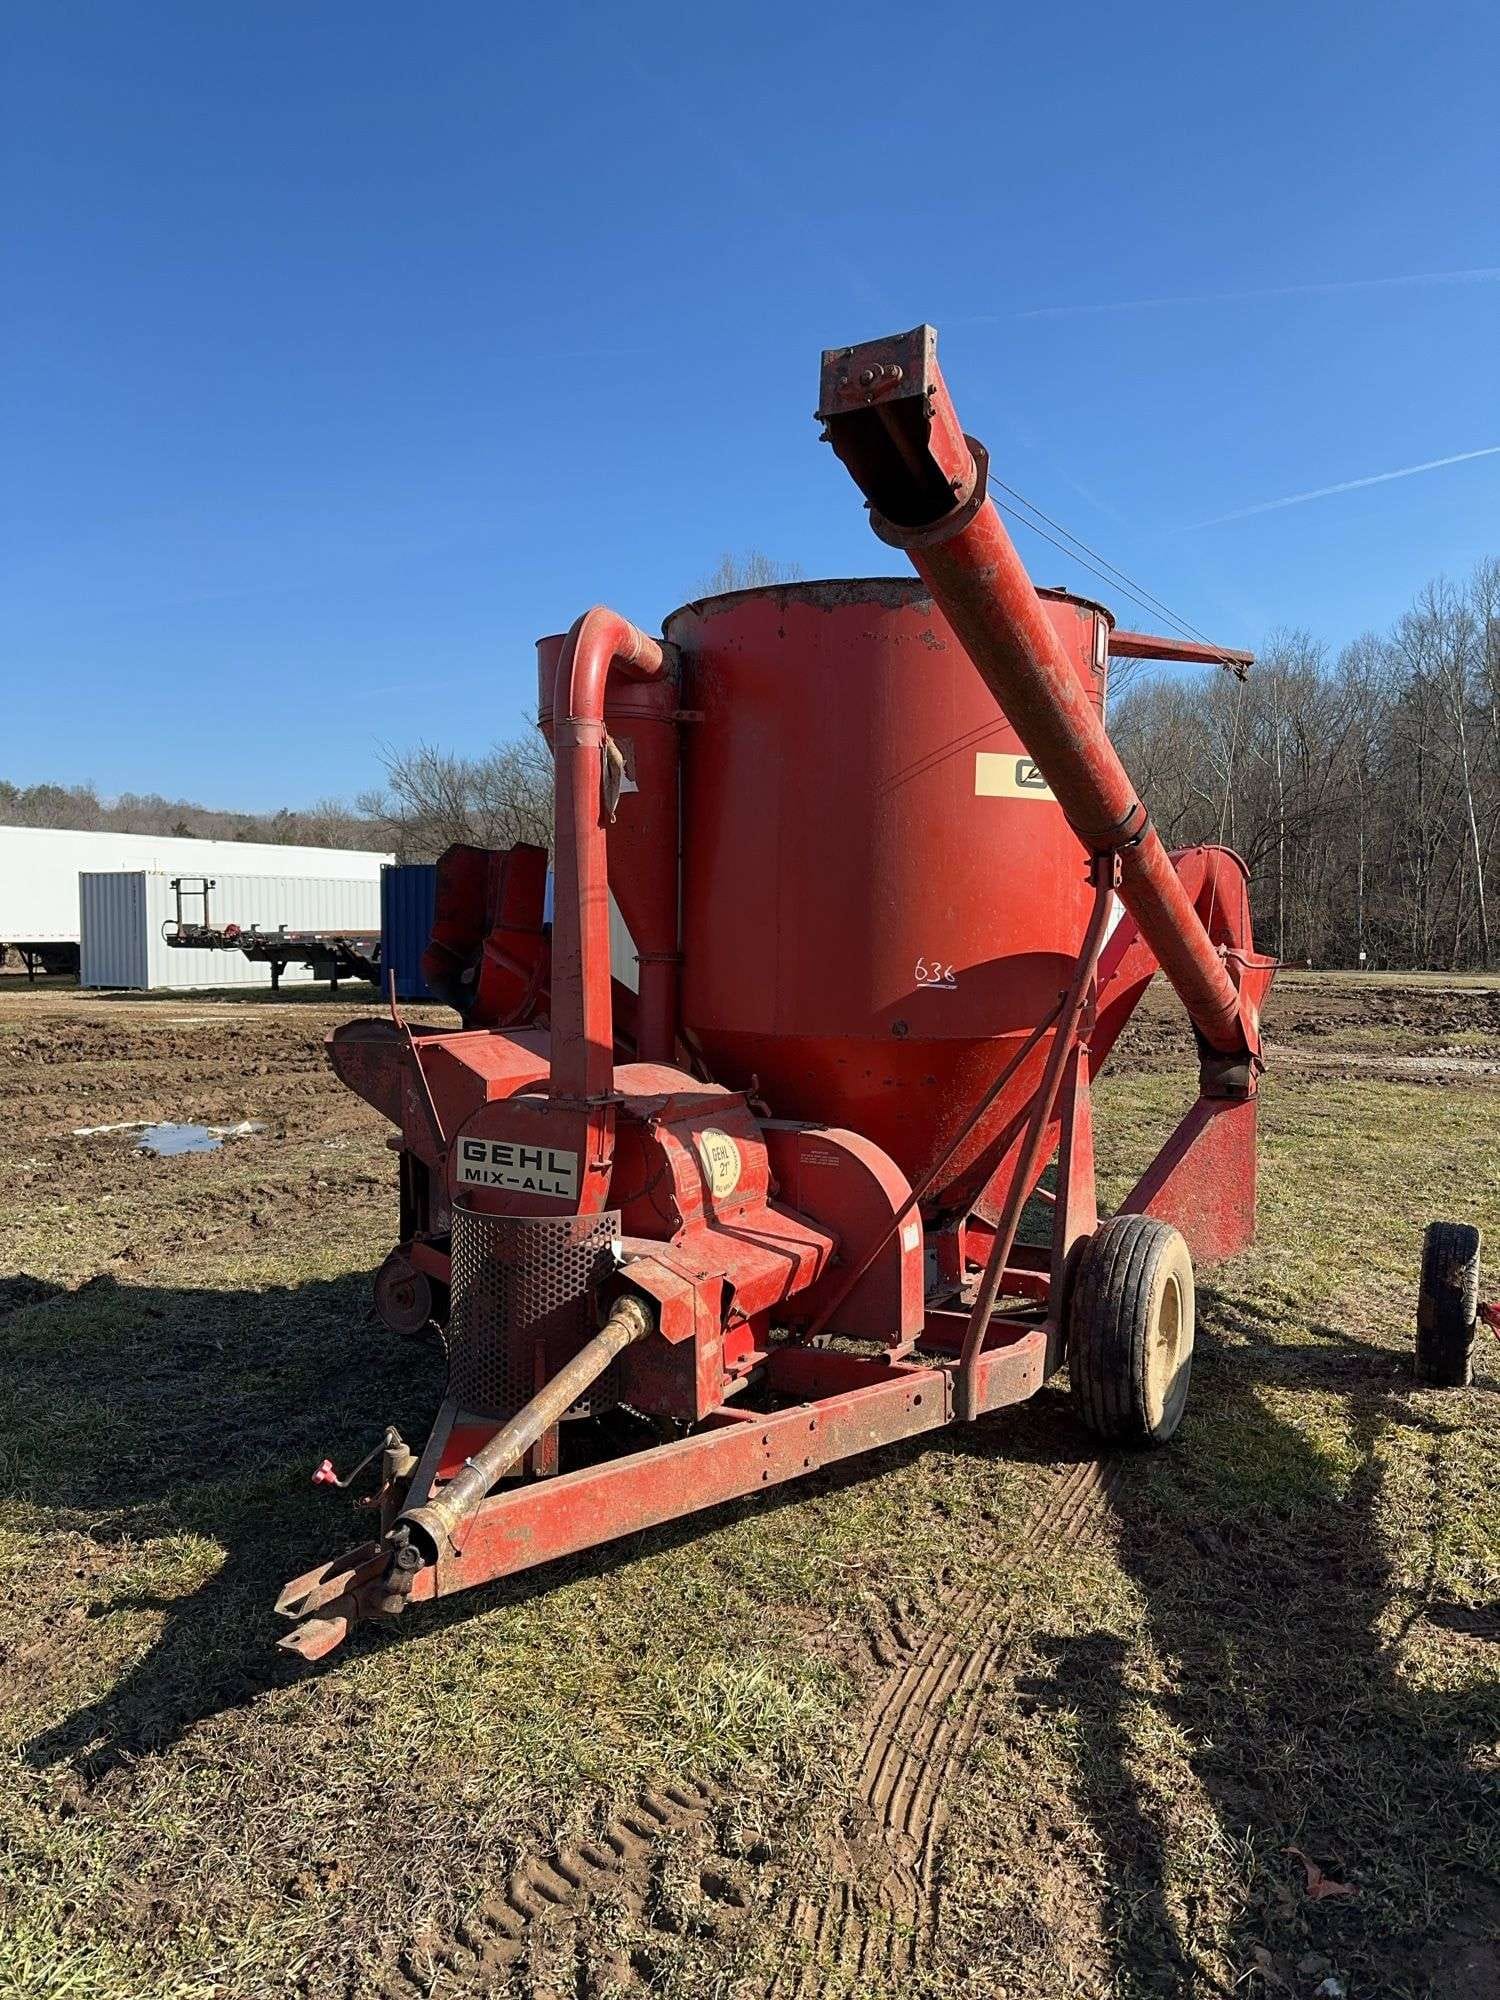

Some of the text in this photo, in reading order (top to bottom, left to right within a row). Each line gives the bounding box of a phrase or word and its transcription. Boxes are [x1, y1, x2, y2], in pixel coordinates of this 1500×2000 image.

[915, 957, 956, 982] 636
[463, 1140, 571, 1175] GEHL
[711, 1145, 729, 1162] GEHL
[464, 1168, 569, 1195] MIX-ALL
